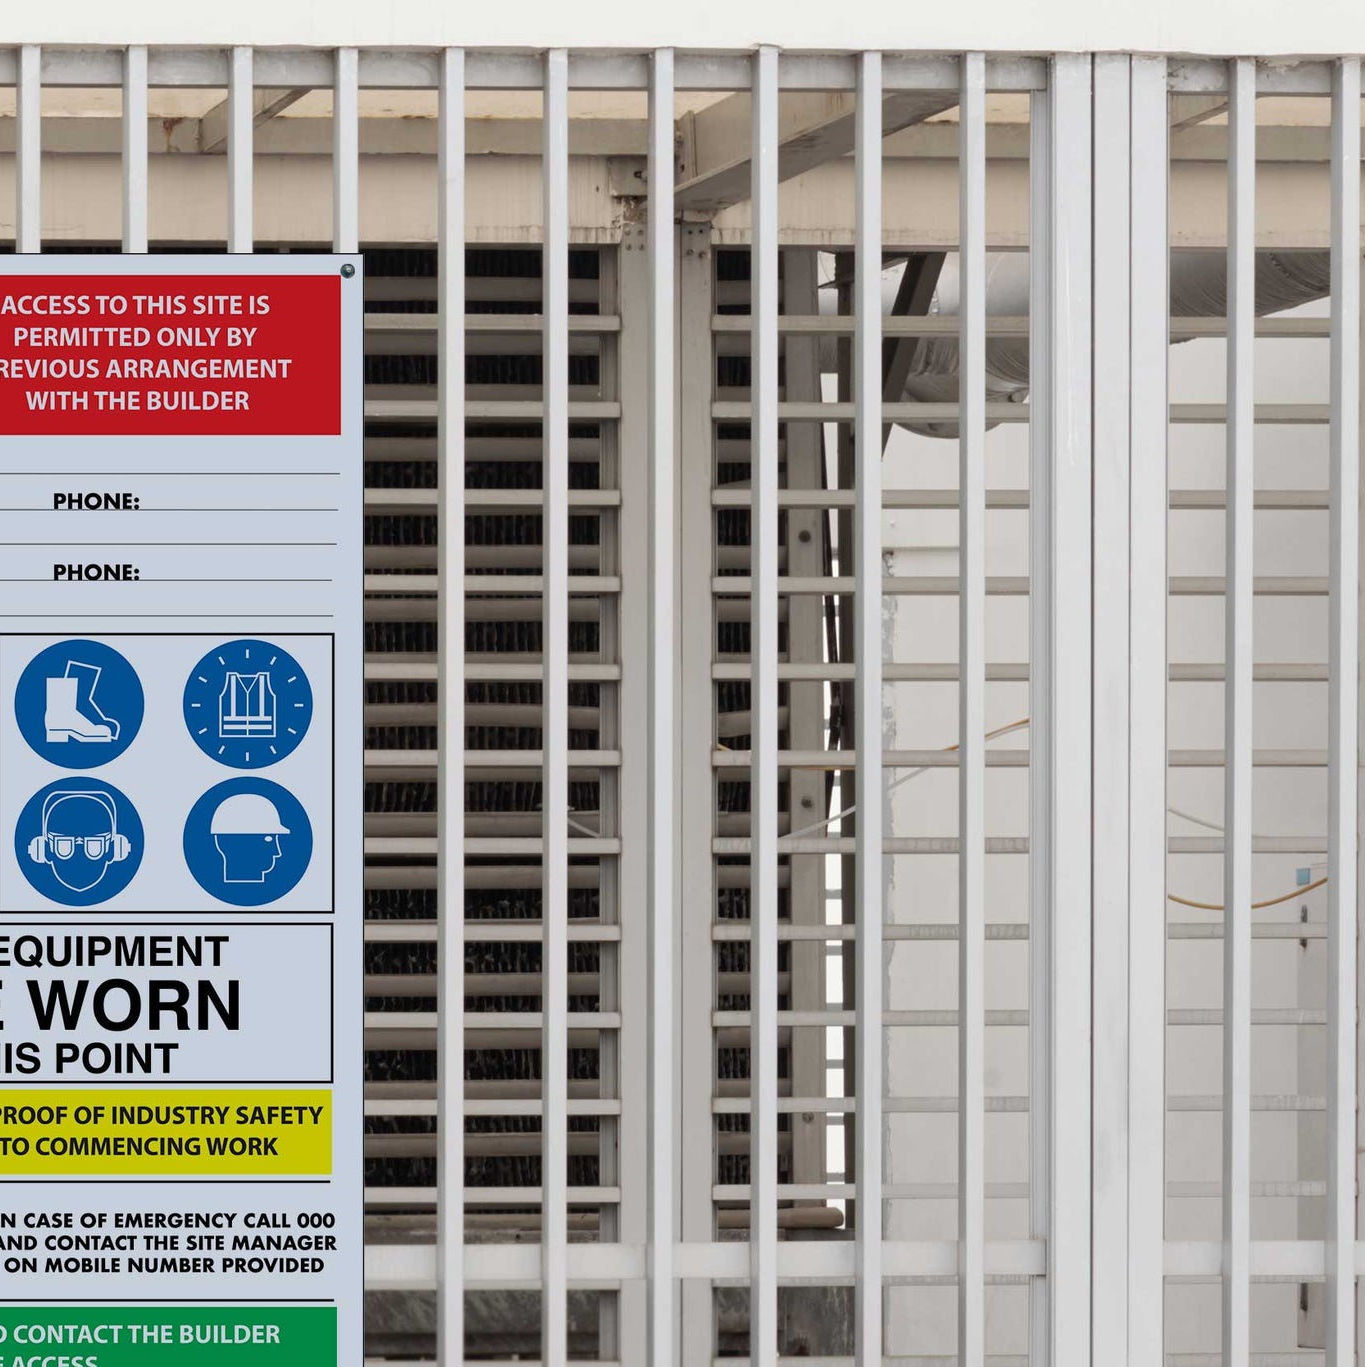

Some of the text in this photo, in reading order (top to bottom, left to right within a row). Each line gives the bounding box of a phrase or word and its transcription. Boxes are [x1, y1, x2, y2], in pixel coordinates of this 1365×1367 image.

[0, 295, 270, 315] ACCESS TO THIS SITE IS
[14, 327, 258, 347] PERMITTED ONLY BY
[105, 358, 293, 379] ARRANGEMENT
[25, 390, 250, 411] WITH THE BUILDER
[52, 492, 141, 511] PHONE:
[52, 563, 141, 582] PHONE:
[25, 978, 240, 1032] WORN
[55, 1041, 179, 1075] POINT
[73, 1105, 105, 1125] OF
[111, 1105, 230, 1125] INDUSTRY
[236, 1105, 324, 1125] SAFETY
[35, 1136, 201, 1156] COMMENCING
[205, 1137, 279, 1156] WORK
[23, 1212, 73, 1229] CASE
[79, 1212, 108, 1229] OF
[114, 1212, 238, 1229] EMERGENCY
[243, 1212, 291, 1229] CALL
[296, 1212, 336, 1229] 000
[44, 1234, 138, 1251] CONTACT
[142, 1235, 179, 1251] THE
[186, 1234, 225, 1251] SITE
[231, 1234, 337, 1251] MANAGER
[3, 1257, 325, 1274] ON MOBILE NUMBER PROVIDED
[13, 1324, 124, 1344] CONTACT
[127, 1324, 173, 1344] THE
[179, 1324, 280, 1344] BUILDER
